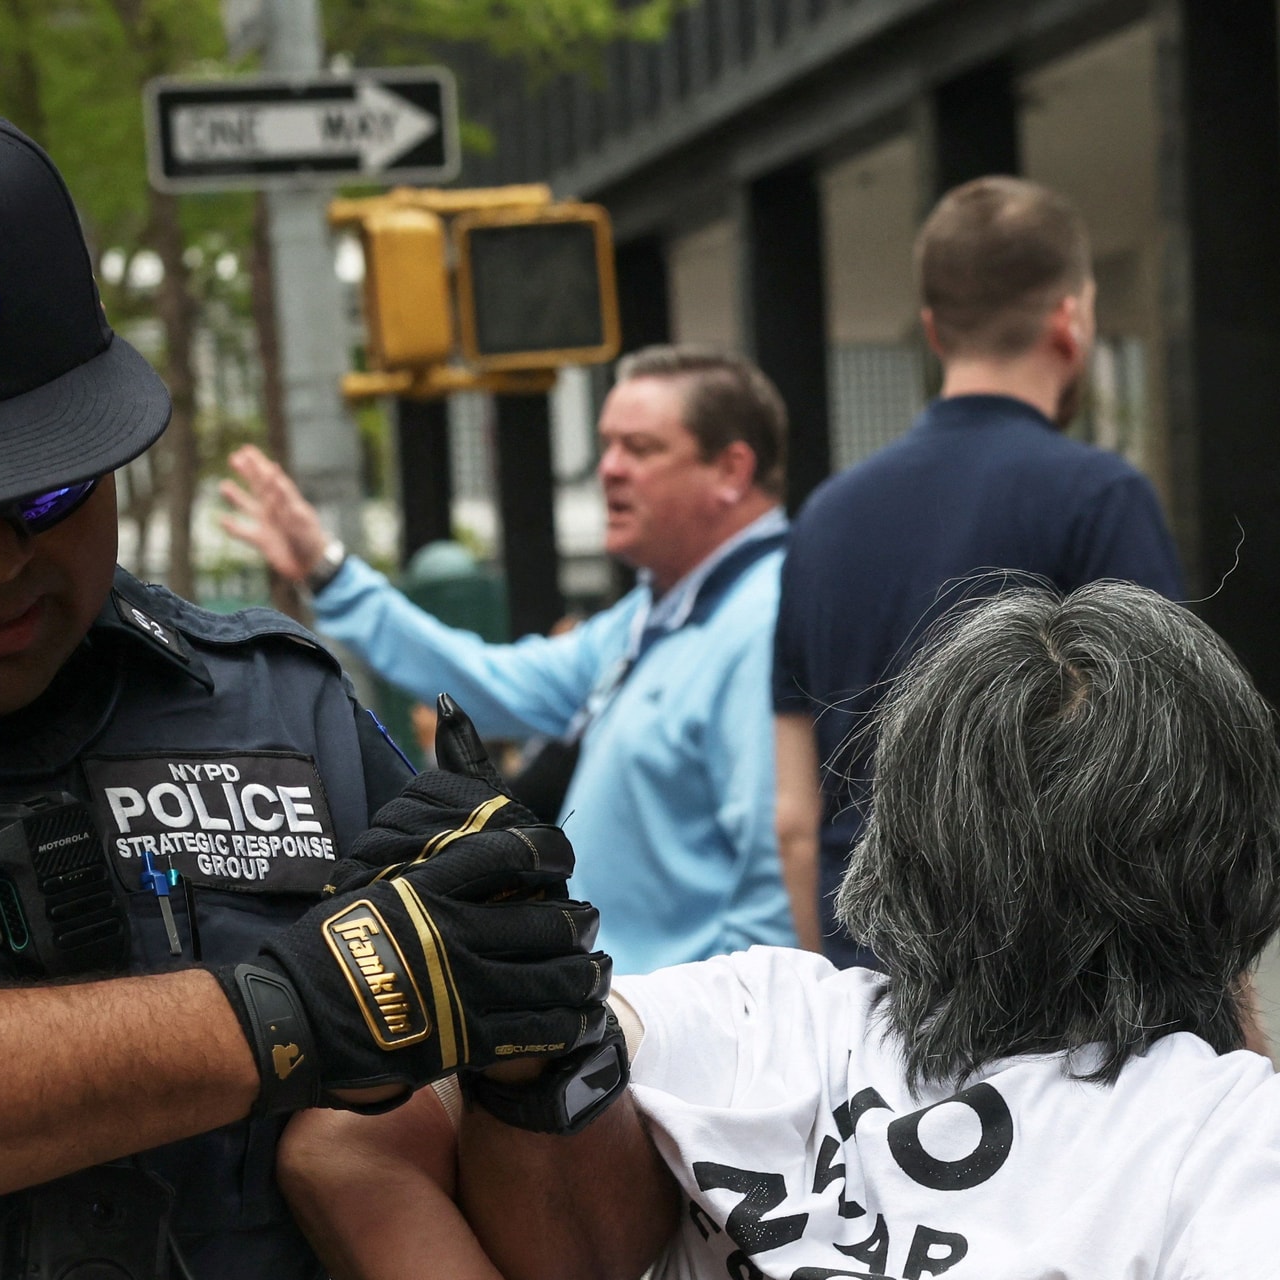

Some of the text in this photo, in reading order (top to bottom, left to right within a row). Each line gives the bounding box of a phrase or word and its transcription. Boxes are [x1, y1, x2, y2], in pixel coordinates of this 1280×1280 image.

[185, 104, 400, 155] ONE WAY
[131, 608, 169, 644] S2
[168, 763, 240, 782] NYPD
[104, 782, 323, 834] POLICE
[38, 831, 89, 853] MOTOROLA
[116, 832, 336, 861] STRATEGIC RESPONSE
[197, 854, 270, 880] GROUP
[332, 917, 411, 1034] Franklin
